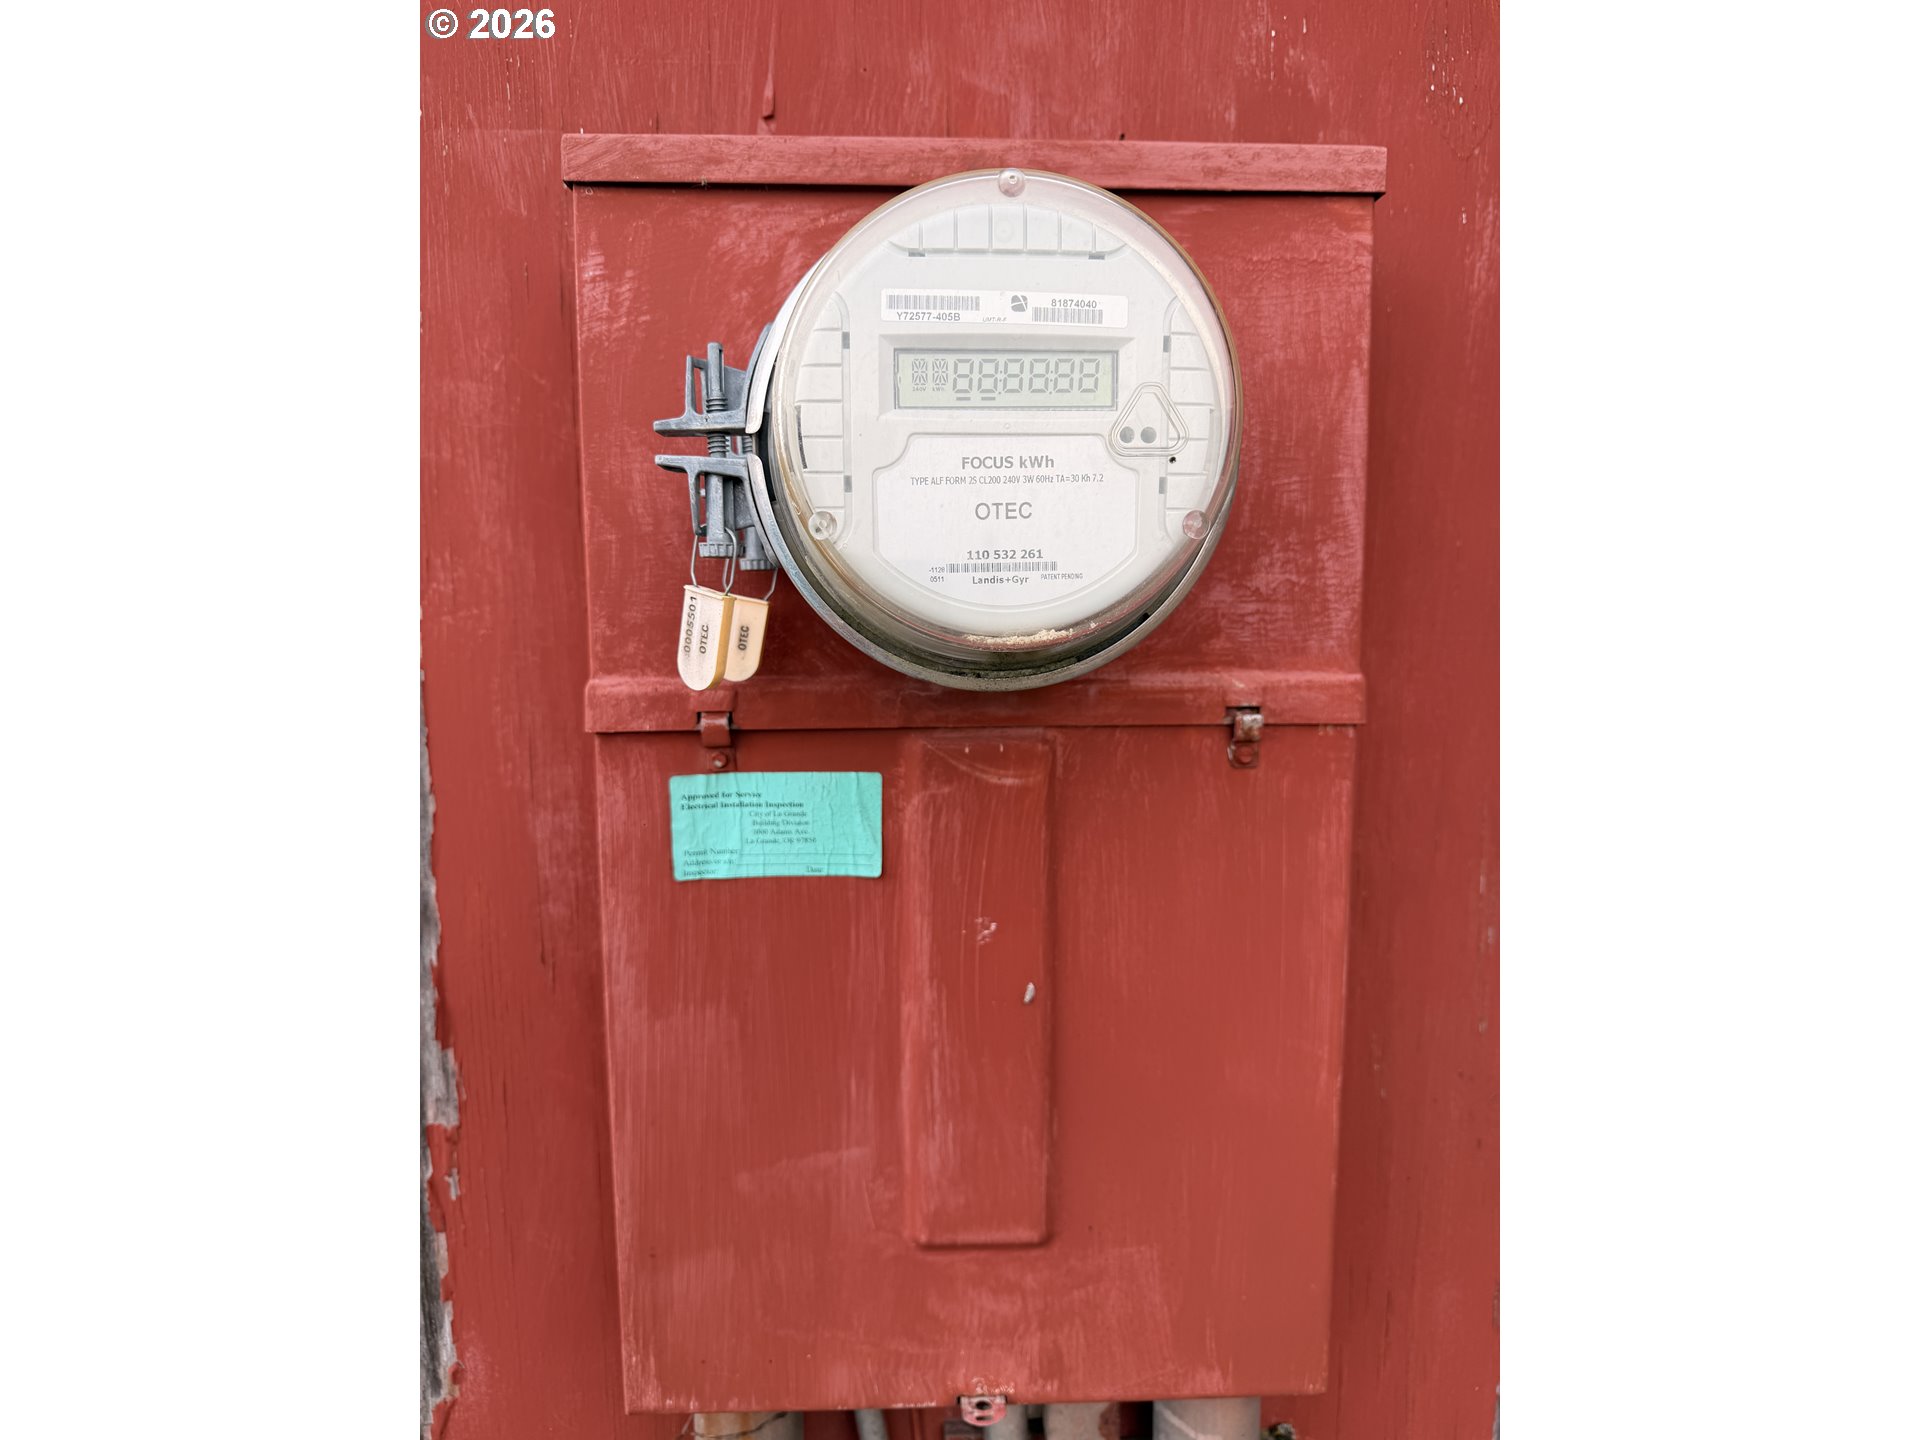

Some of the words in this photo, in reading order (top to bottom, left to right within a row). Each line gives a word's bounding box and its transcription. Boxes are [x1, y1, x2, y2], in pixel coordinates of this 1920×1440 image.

[1051, 298, 1097, 309] 81874040
[896, 311, 961, 321] Y72577-405B
[961, 455, 1014, 470] FOCUS
[1019, 455, 1055, 469] kWh
[911, 476, 929, 486] TYPE
[931, 476, 944, 486] ALF
[945, 476, 967, 485] FORM
[968, 475, 978, 485] 2S
[978, 475, 1001, 485] CL200
[1003, 475, 1021, 484] 240V
[1022, 474, 1035, 484] 3W
[1036, 474, 1054, 484] 60Hz
[1056, 474, 1080, 483] TA=30
[1081, 473, 1091, 482] Kh
[1092, 473, 1104, 482] 7.2
[974, 502, 1033, 520] OTEC
[966, 550, 990, 560] 110
[993, 549, 1017, 560] 532
[1020, 549, 1044, 559] 261
[972, 575, 1030, 586] Landis+Gyr
[699, 624, 709, 654] OTEC
[738, 625, 750, 651] OTEC
[720, 800, 763, 809] Installation
[765, 800, 804, 809] Inspection
